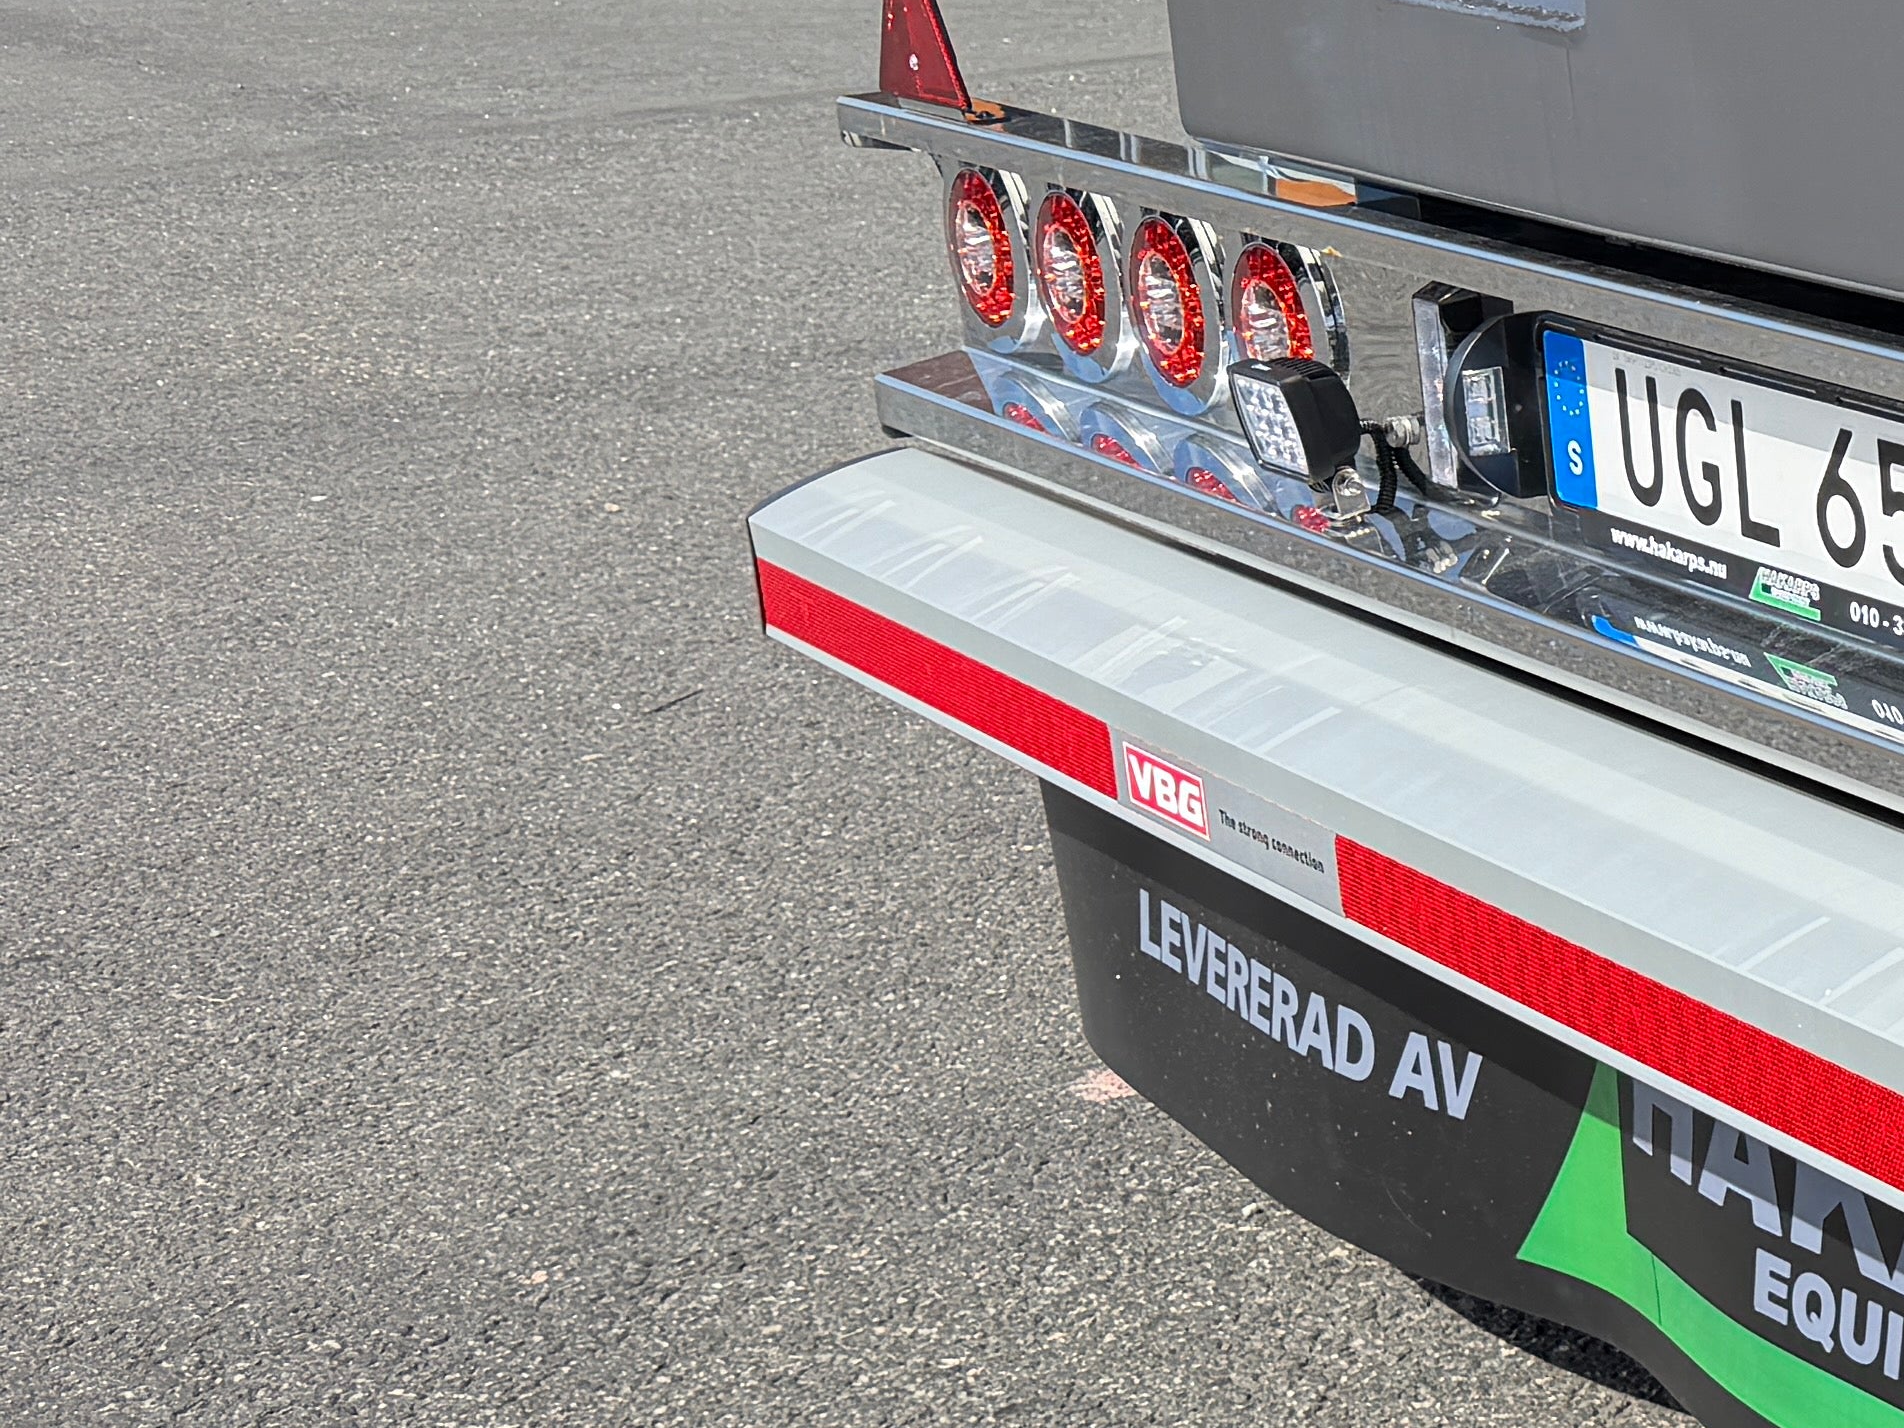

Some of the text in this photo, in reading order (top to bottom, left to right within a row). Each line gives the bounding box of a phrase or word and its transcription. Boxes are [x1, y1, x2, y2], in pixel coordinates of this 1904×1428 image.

[1566, 440, 1584, 476] S
[1613, 368, 1781, 547] UGL
[1610, 527, 1728, 580] www.hakarps.nu
[1849, 602, 1879, 629] 010
[1128, 754, 1204, 828] VBG
[1219, 809, 1325, 874] The strong connection
[1138, 888, 1483, 1121] LEVERERAD AV
